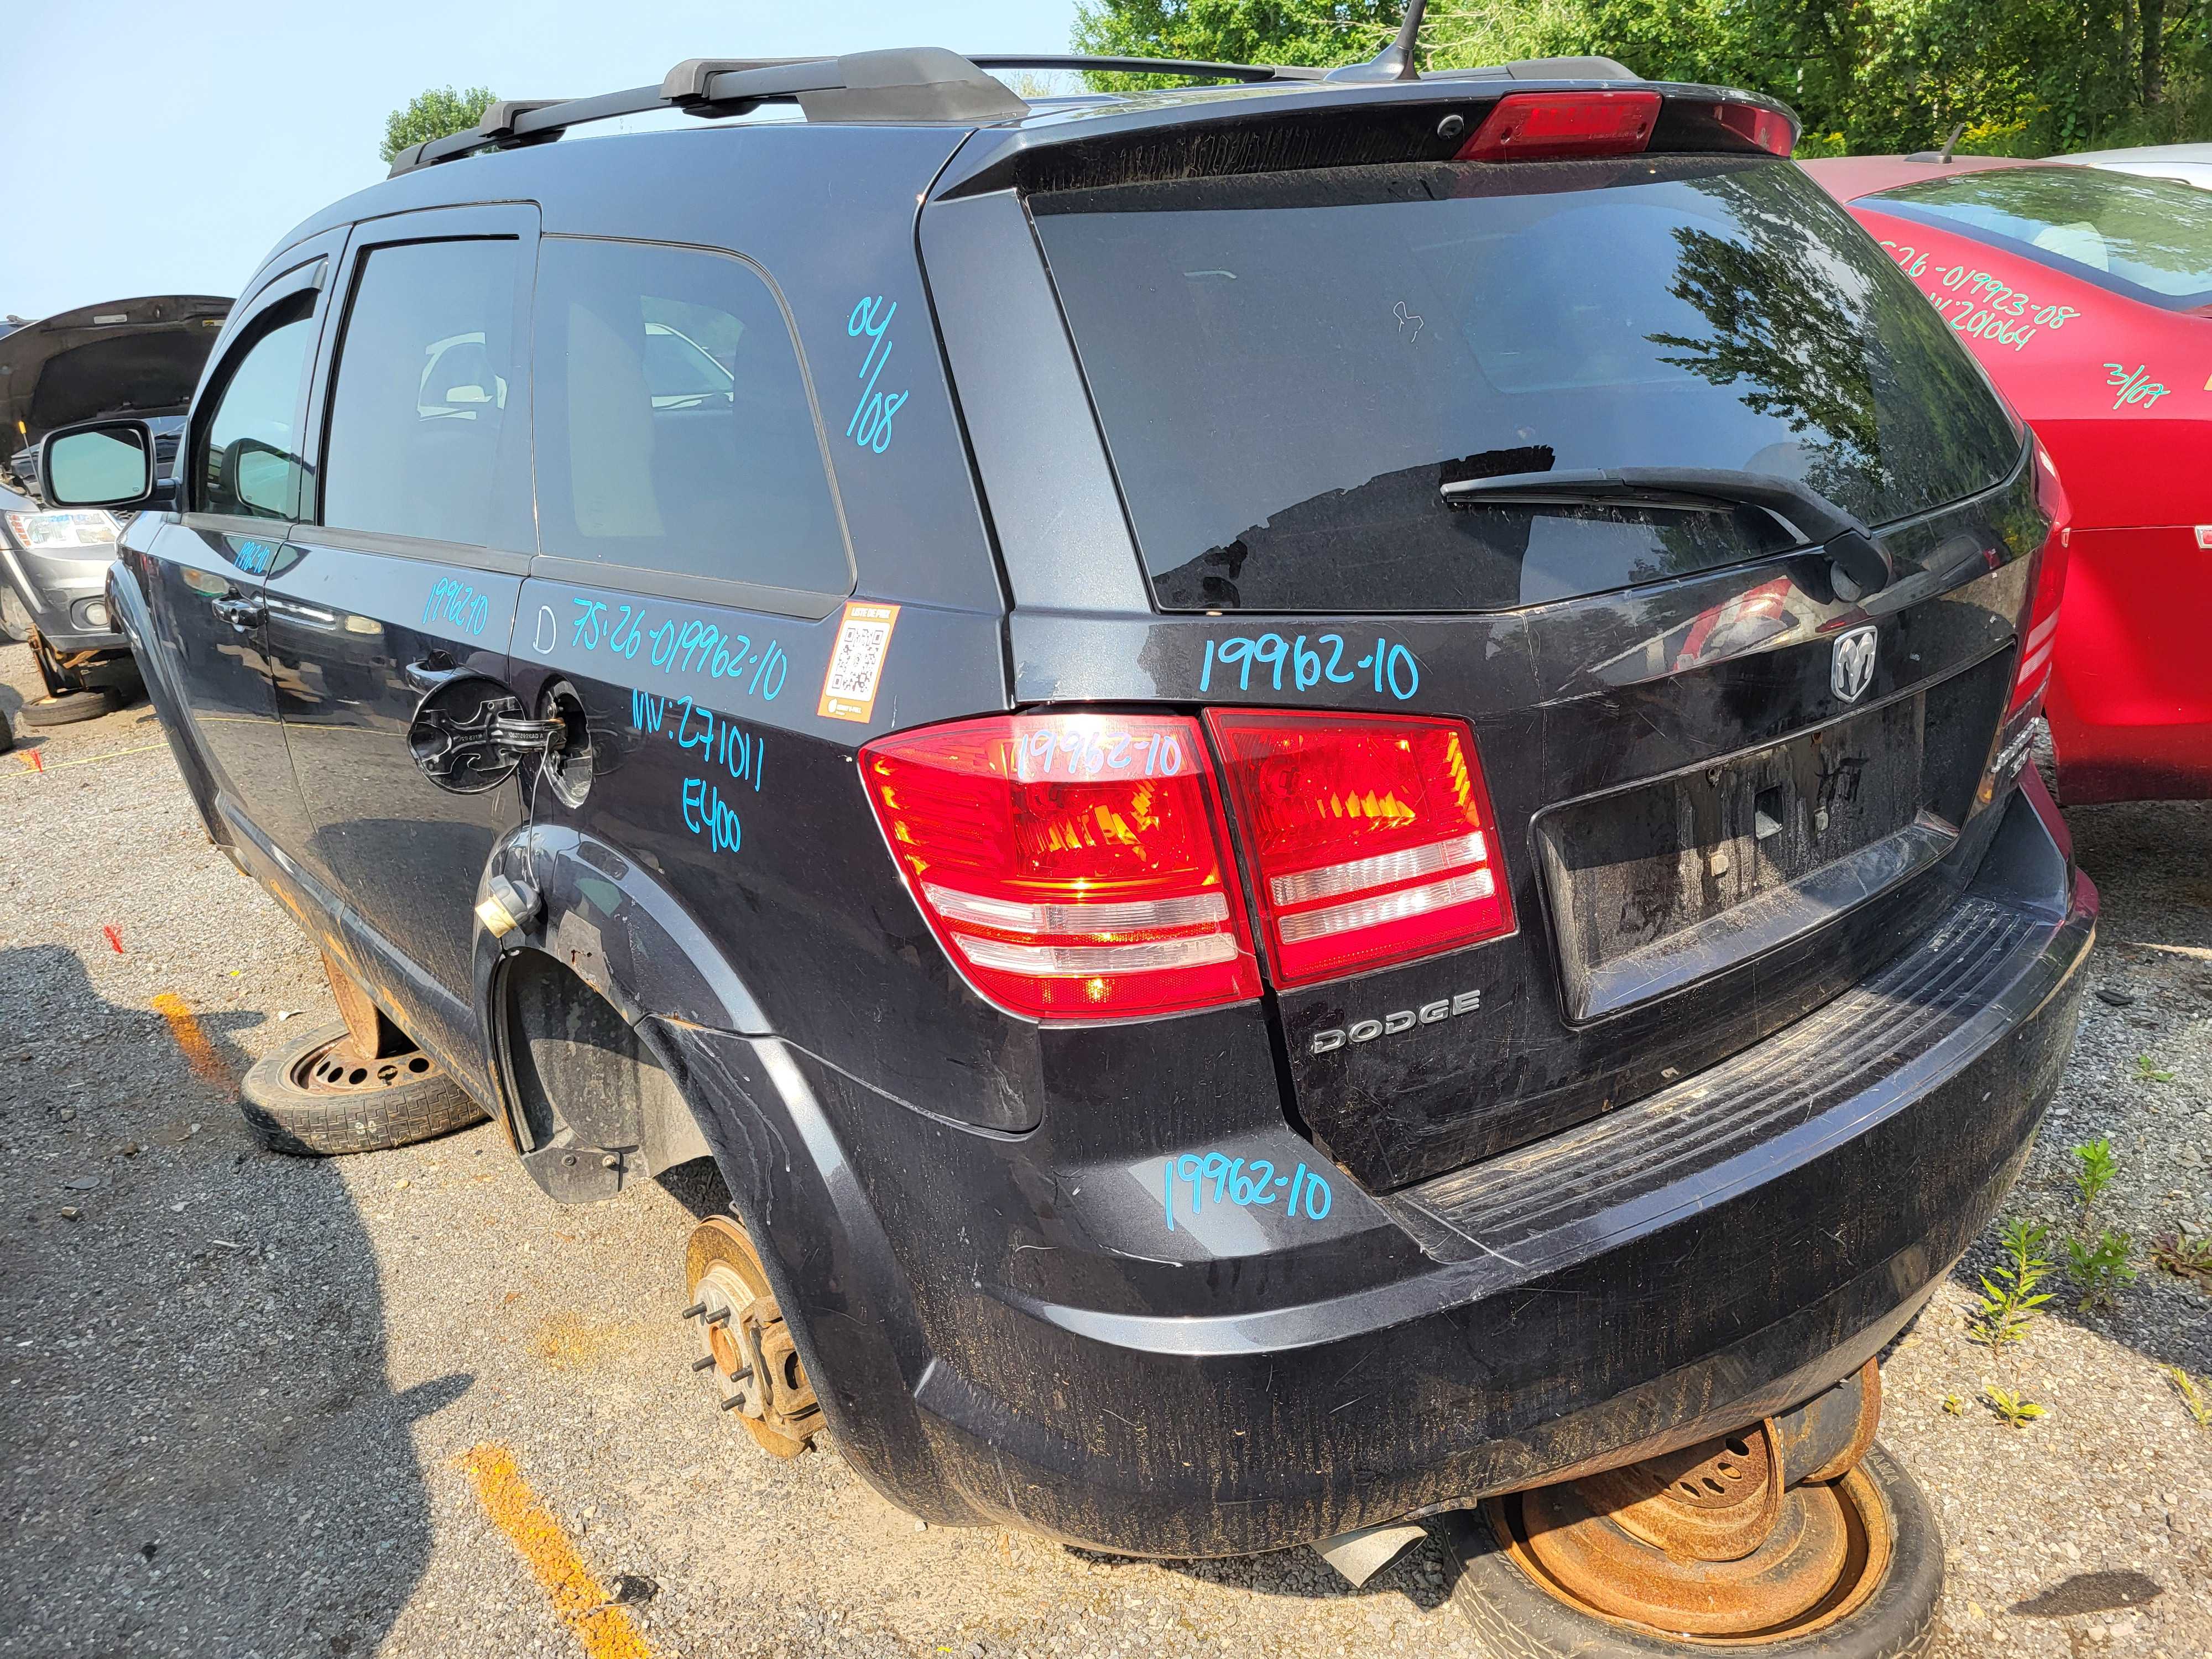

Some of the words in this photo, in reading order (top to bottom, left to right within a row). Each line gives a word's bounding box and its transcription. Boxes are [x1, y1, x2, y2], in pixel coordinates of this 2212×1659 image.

[422, 576, 489, 636] 19962-10
[533, 605, 557, 655] D
[1199, 633, 1420, 700] 19962-10
[1018, 729, 1181, 780] 19962-10
[682, 778, 742, 853] E400
[1314, 989, 1481, 1054] DODGE
[1165, 1151, 1332, 1232] 19962-10
